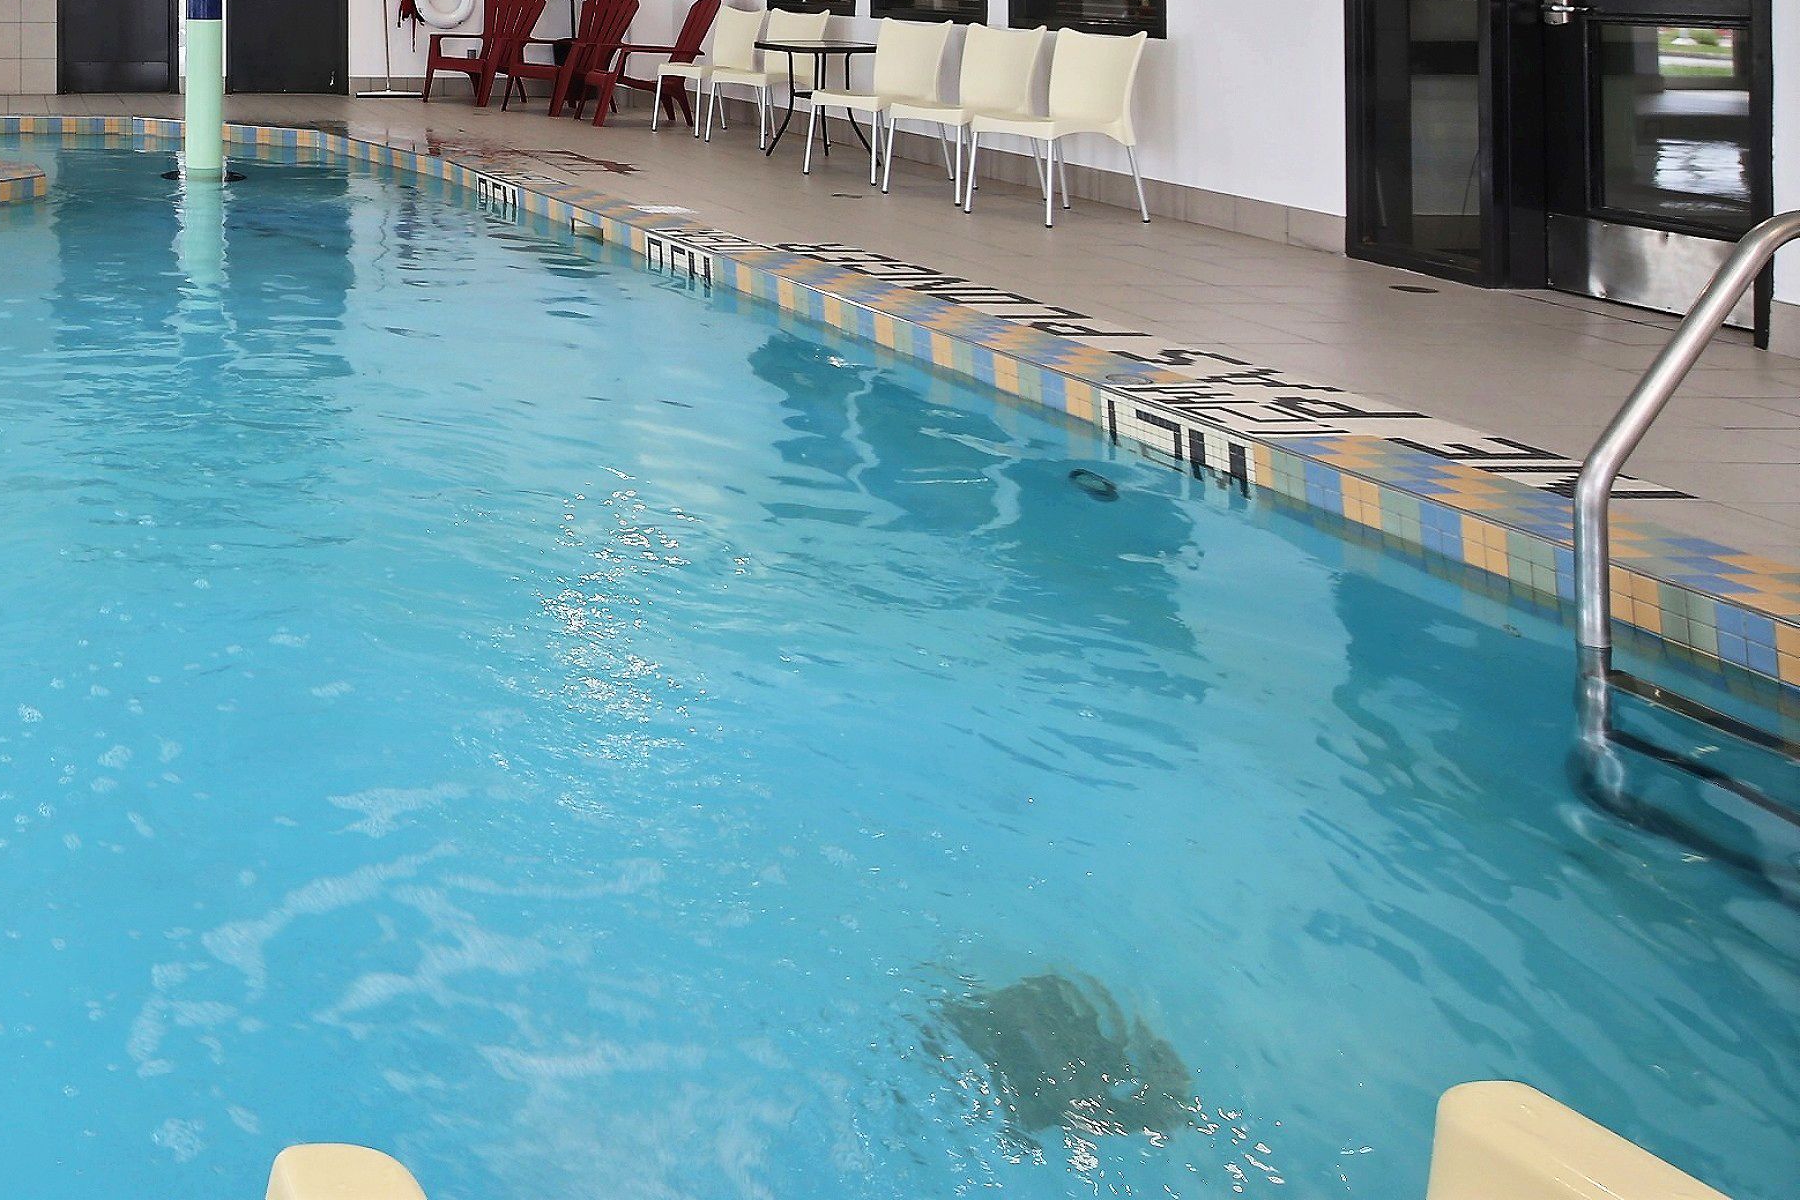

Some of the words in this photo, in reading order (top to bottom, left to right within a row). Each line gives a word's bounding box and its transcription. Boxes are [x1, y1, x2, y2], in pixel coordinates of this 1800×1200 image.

[775, 243, 1153, 337] PLONGER
[1107, 349, 1434, 419] PAS
[1381, 437, 1701, 500] NE
